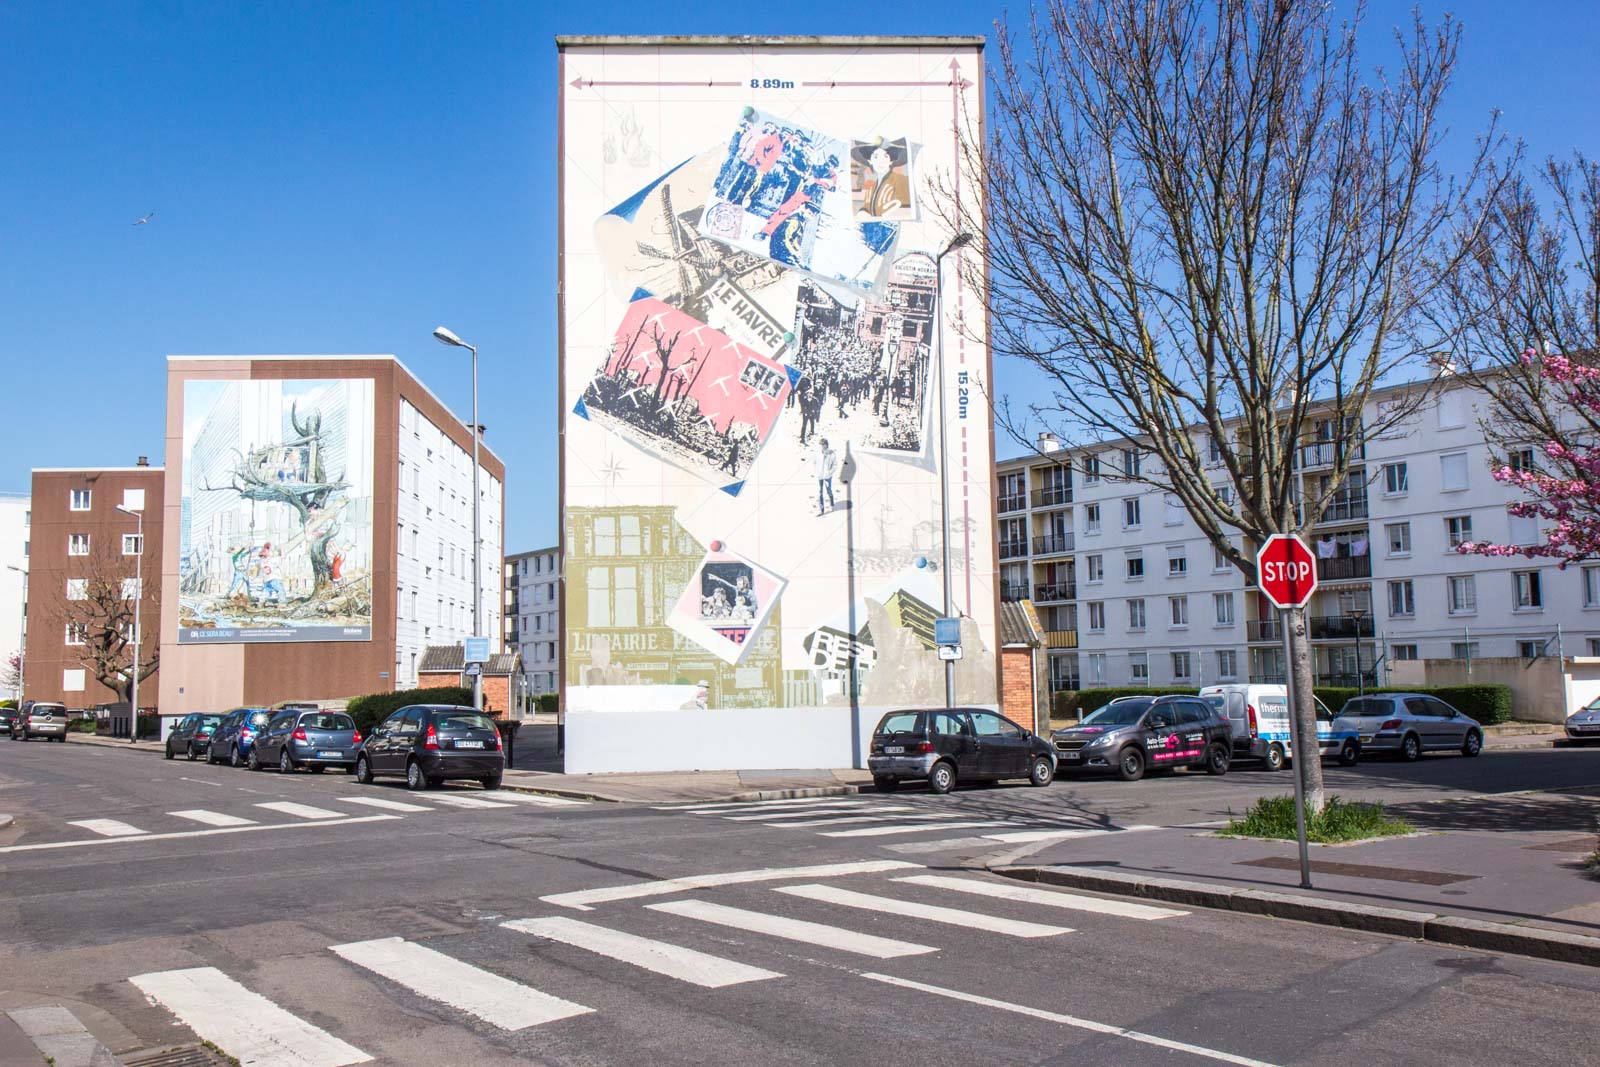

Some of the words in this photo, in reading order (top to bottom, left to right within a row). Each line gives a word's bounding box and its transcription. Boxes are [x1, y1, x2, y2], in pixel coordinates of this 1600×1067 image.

[750, 78, 795, 90] 8.89m
[731, 299, 782, 349] HAVRE
[957, 371, 969, 419] 15.20m
[1264, 560, 1310, 583] STOP
